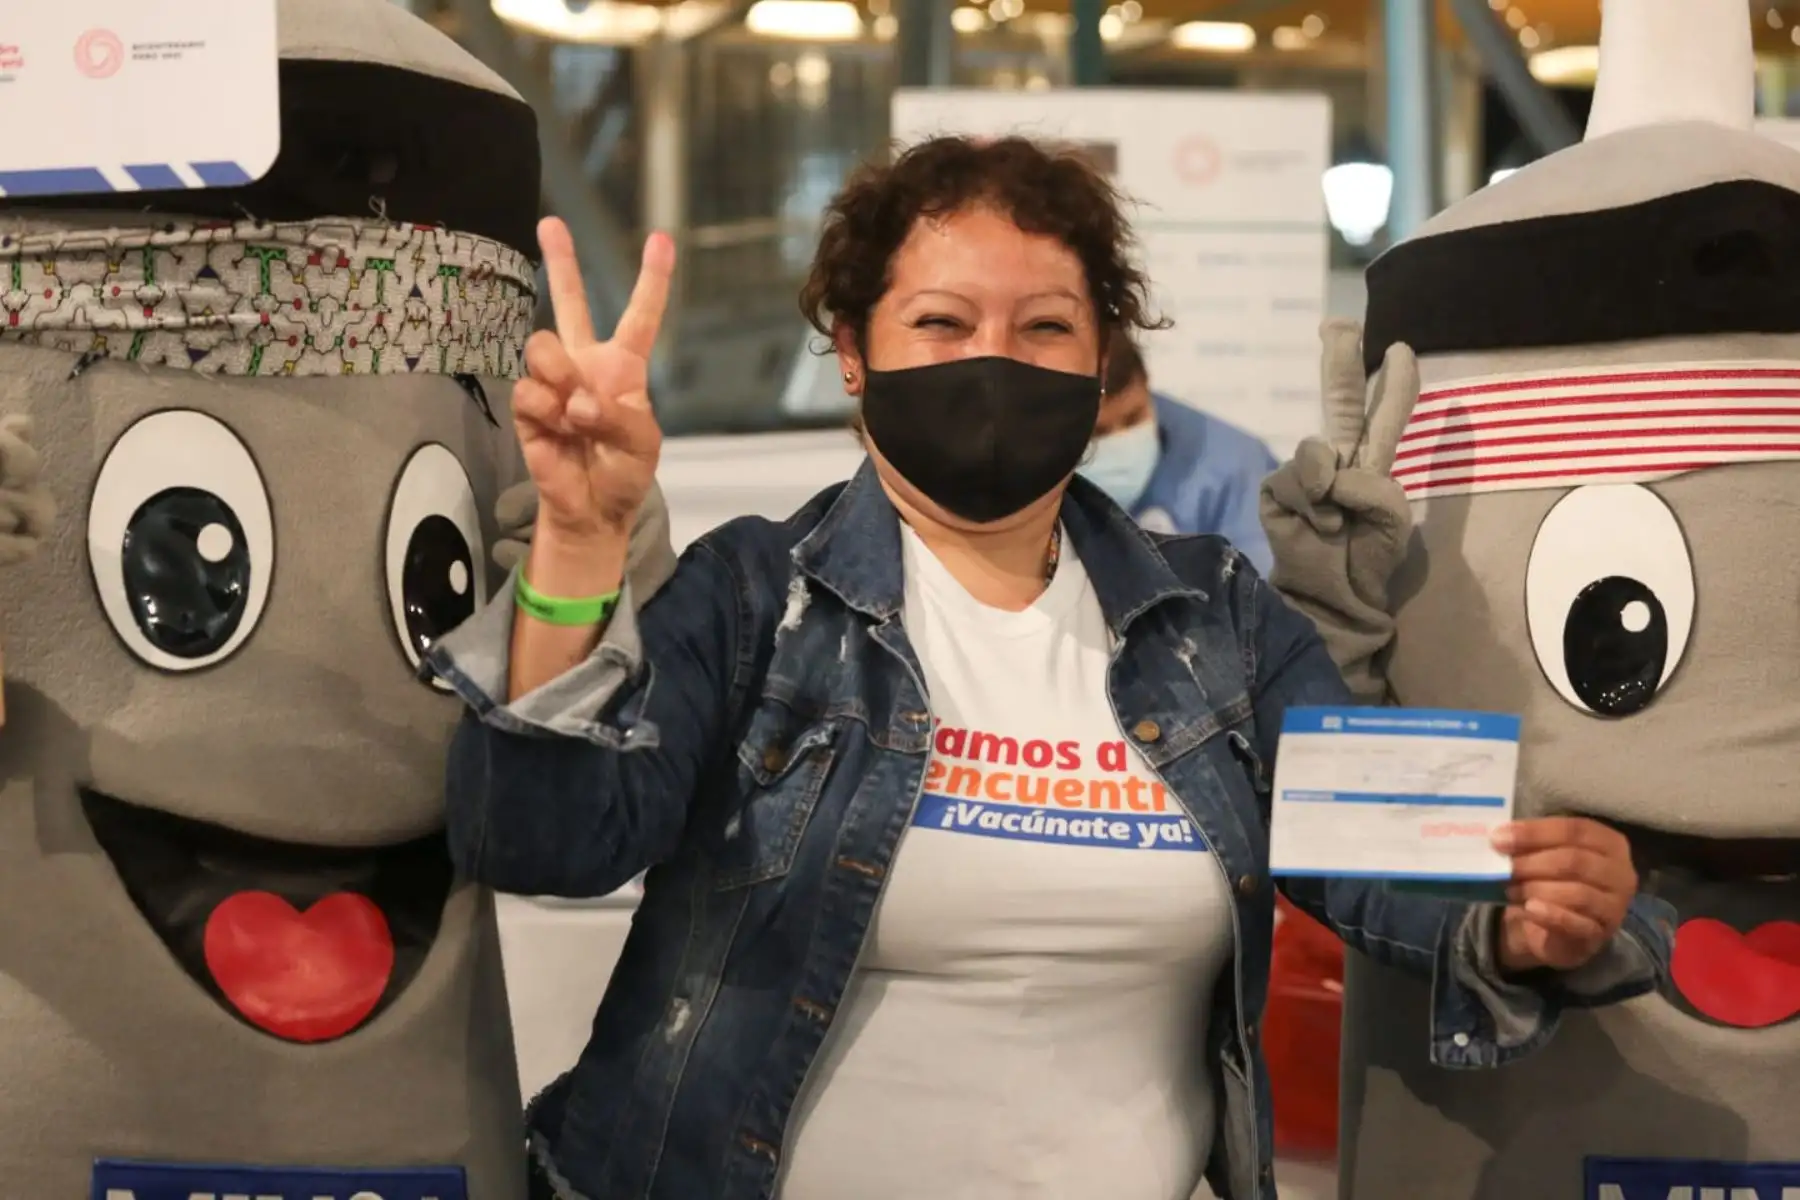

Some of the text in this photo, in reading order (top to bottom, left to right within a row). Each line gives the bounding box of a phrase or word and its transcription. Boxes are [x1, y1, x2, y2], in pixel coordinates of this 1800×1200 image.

[932, 716, 1128, 772] amos a
[941, 802, 1194, 848] ¡Vacúnate ya!
